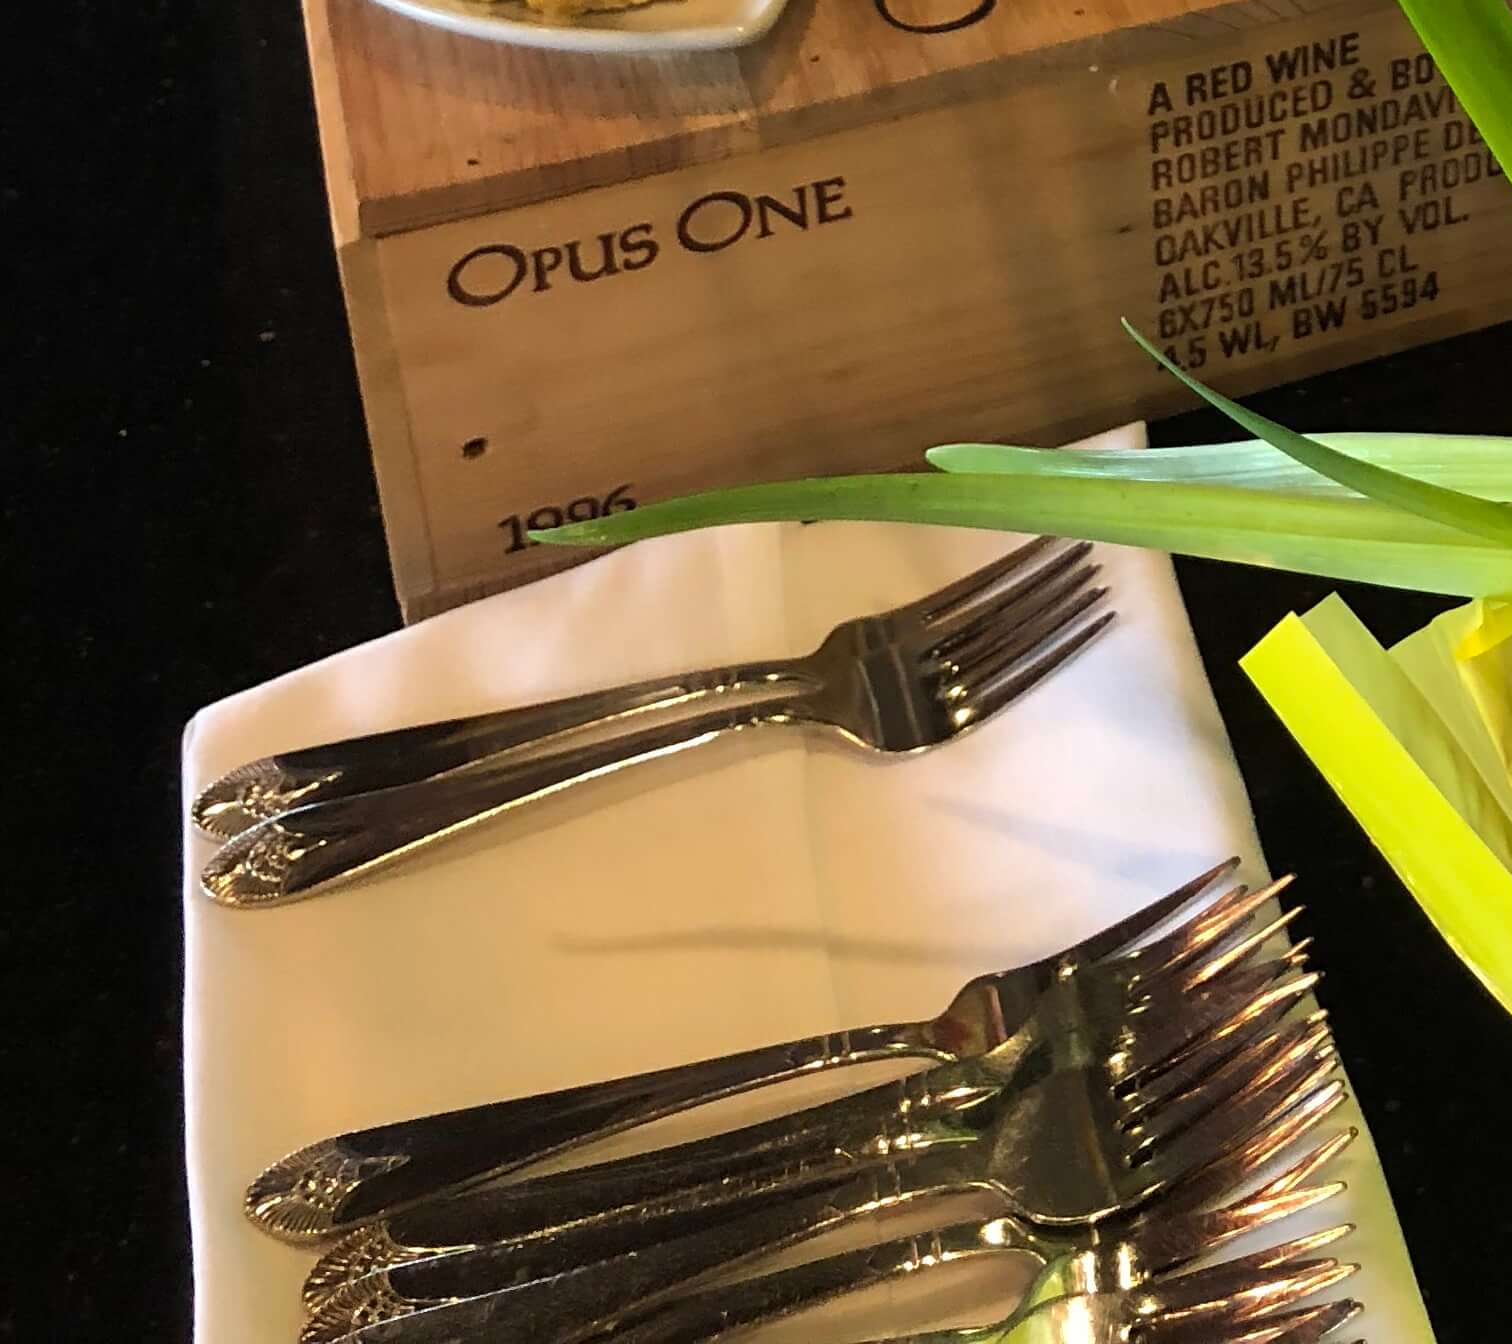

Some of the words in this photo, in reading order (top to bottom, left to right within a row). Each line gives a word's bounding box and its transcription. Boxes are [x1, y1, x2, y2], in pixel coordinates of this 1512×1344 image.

[1148, 82, 1173, 115] A
[1186, 61, 1253, 106] RED
[1265, 31, 1360, 84] WINE
[1151, 80, 1333, 154] PRODUCED
[1347, 66, 1377, 100] &
[1151, 128, 1286, 191] ROBERT
[1299, 85, 1457, 153] MONDAVI
[1152, 170, 1270, 229] BARON
[1286, 128, 1431, 193] PHILIPPE
[447, 222, 660, 307] OPUS
[677, 175, 854, 253] ONE
[1155, 196, 1321, 266] OAKVILLE,
[1336, 181, 1380, 217] CA
[1341, 214, 1385, 253] BY
[1398, 195, 1470, 235] VOL.
[1159, 286, 1255, 339] 6X750
[1268, 256, 1365, 310] ML/75
[1377, 244, 1420, 278] CL
[1292, 295, 1348, 339] BW
